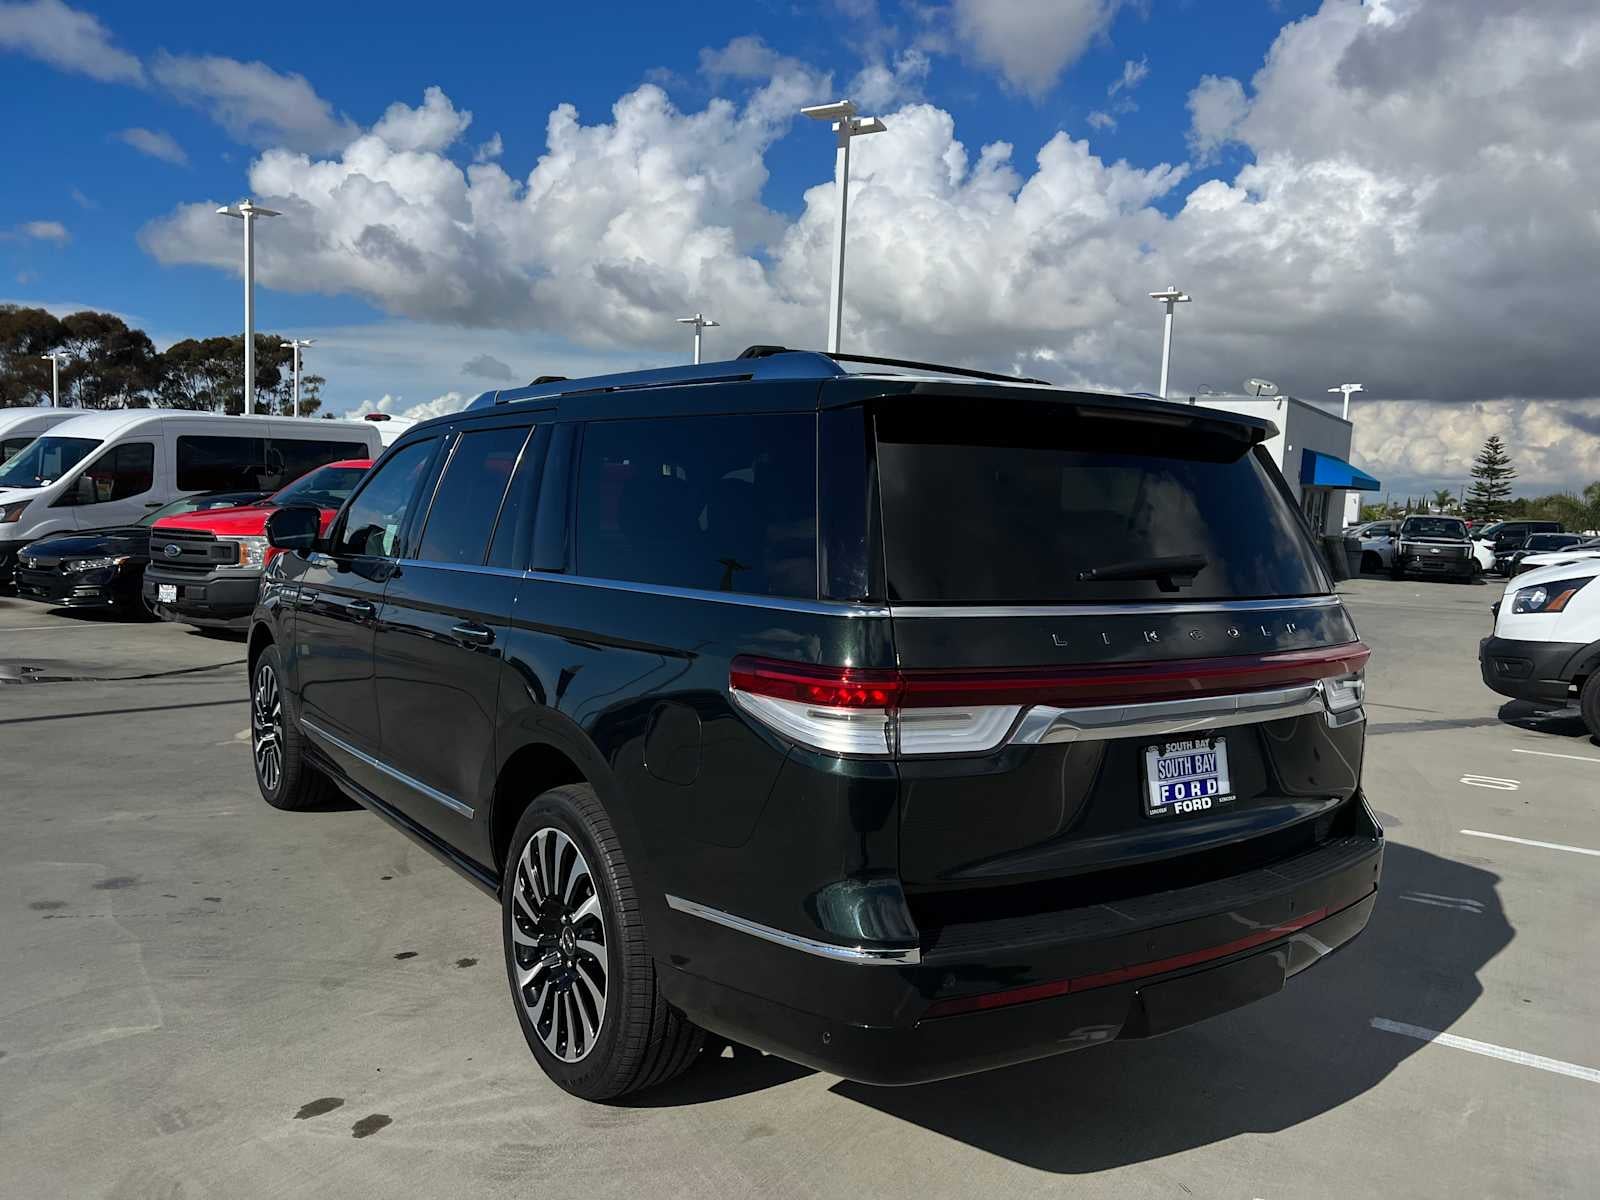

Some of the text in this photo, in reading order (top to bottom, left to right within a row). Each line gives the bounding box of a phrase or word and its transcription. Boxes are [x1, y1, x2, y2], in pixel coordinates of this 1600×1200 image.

[1166, 738, 1210, 752] SOUTH BAY
[1158, 754, 1215, 779] SOUTH BAY
[1161, 779, 1217, 801] FORD
[1174, 797, 1211, 814] FORD
